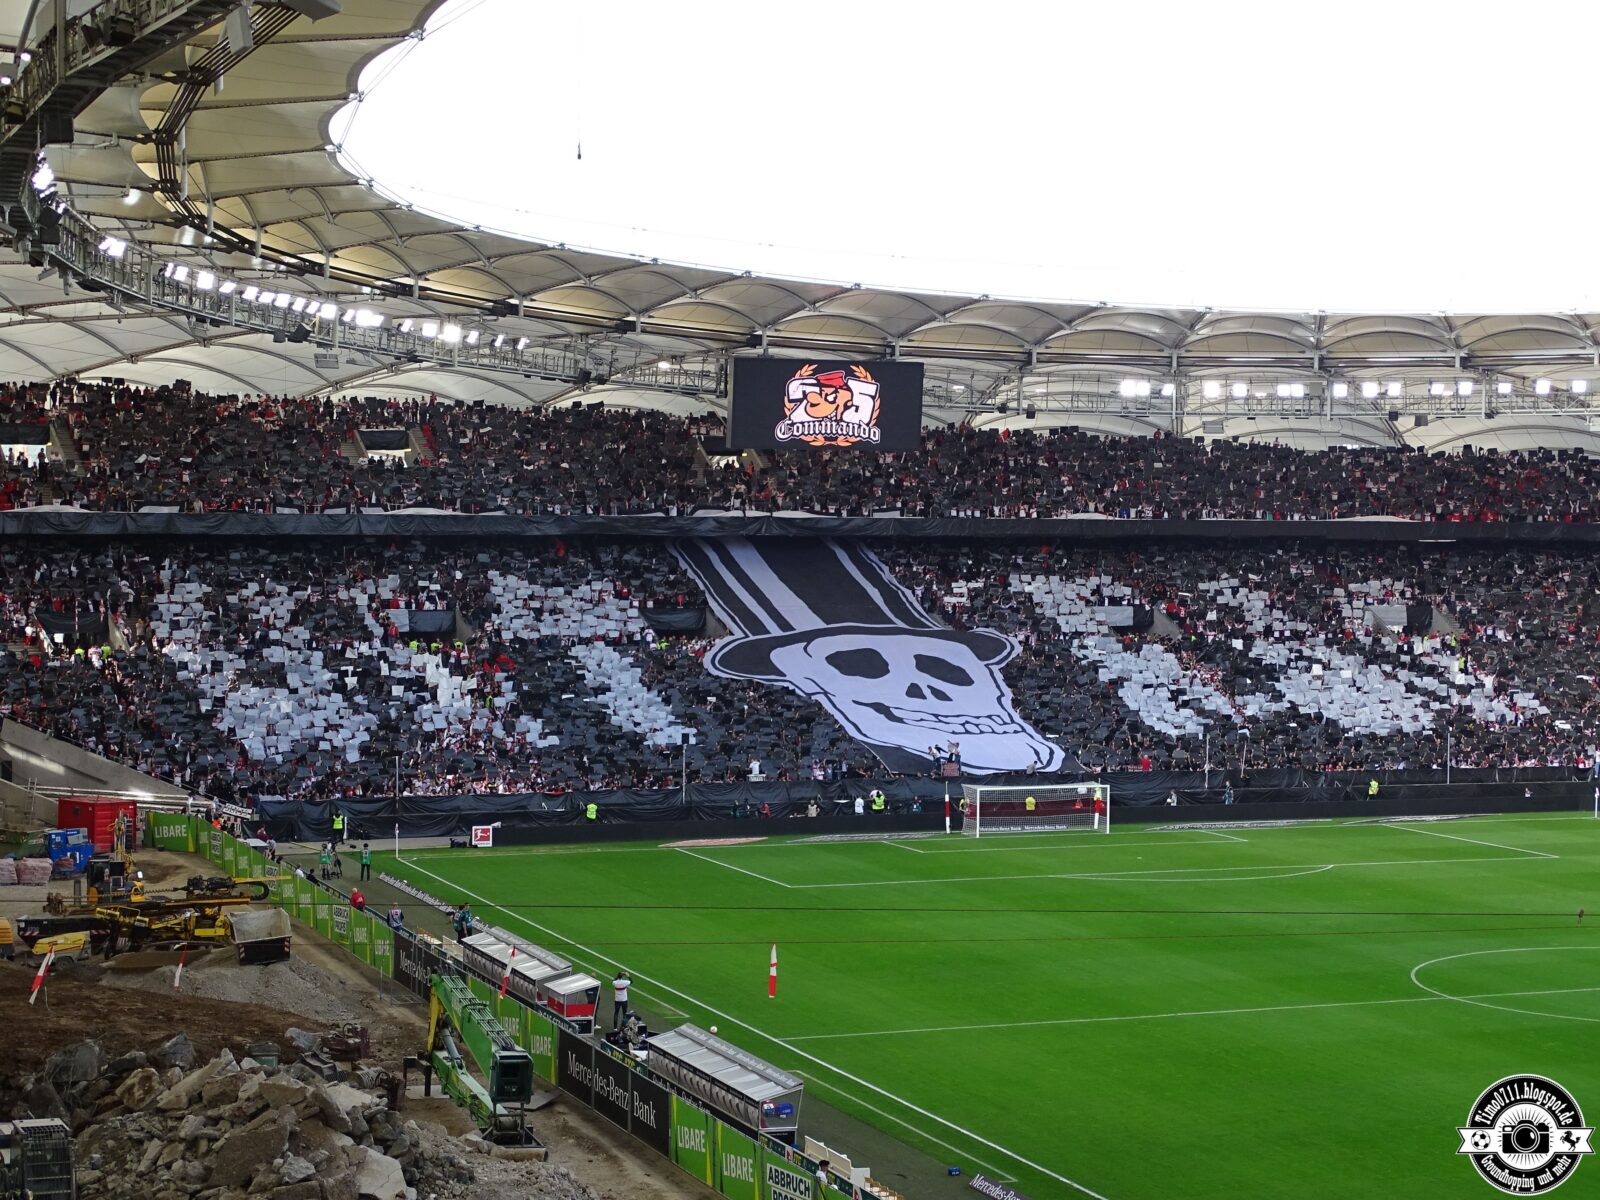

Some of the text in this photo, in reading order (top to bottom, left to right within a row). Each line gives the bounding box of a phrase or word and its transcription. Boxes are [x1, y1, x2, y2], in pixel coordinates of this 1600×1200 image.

[775, 419, 881, 443] Commando
[154, 824, 188, 839] LIBARE
[531, 1034, 552, 1056] LIBARE
[633, 1091, 656, 1129] Bank
[677, 1125, 706, 1153] LIBARE
[722, 1153, 754, 1183] LIBARE
[768, 1166, 811, 1198] ABBRUCH
